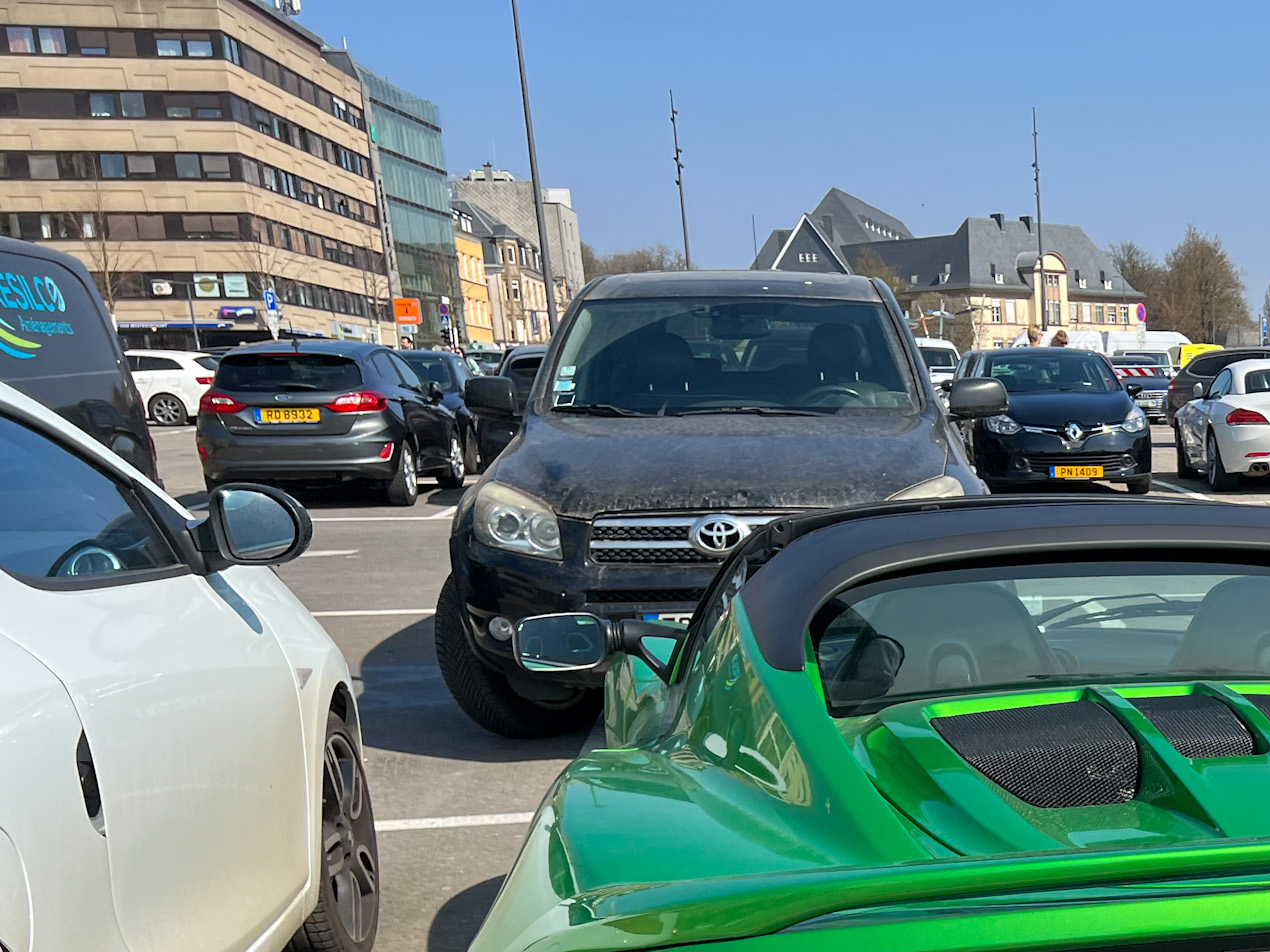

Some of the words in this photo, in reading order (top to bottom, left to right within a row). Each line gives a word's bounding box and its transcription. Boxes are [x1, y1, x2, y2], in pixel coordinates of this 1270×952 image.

[266, 409, 281, 419] RD
[283, 409, 313, 420] 8932
[1060, 467, 1073, 477] PN
[1075, 467, 1098, 476] 1409
